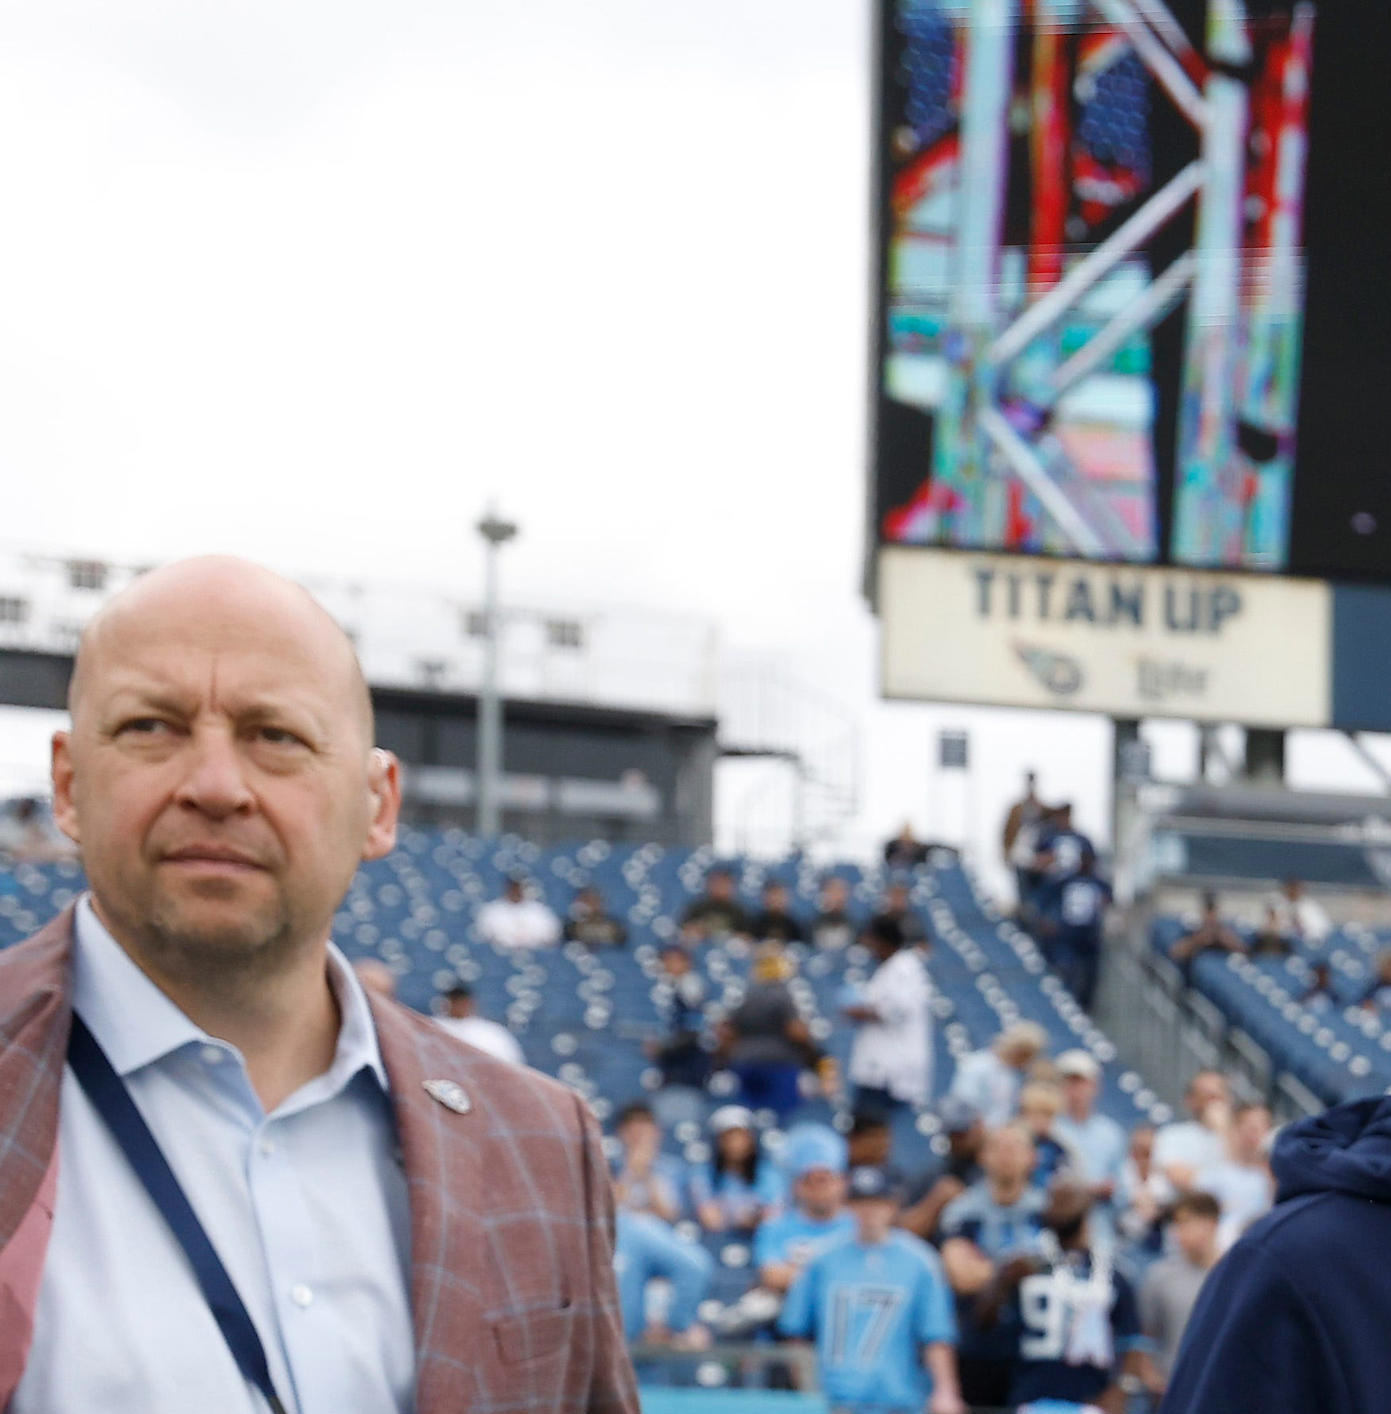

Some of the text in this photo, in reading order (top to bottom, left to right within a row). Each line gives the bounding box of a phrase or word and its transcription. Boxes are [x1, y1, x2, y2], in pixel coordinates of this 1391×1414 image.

[968, 564, 1245, 634] TITAN UP
[826, 1283, 906, 1368] 17
